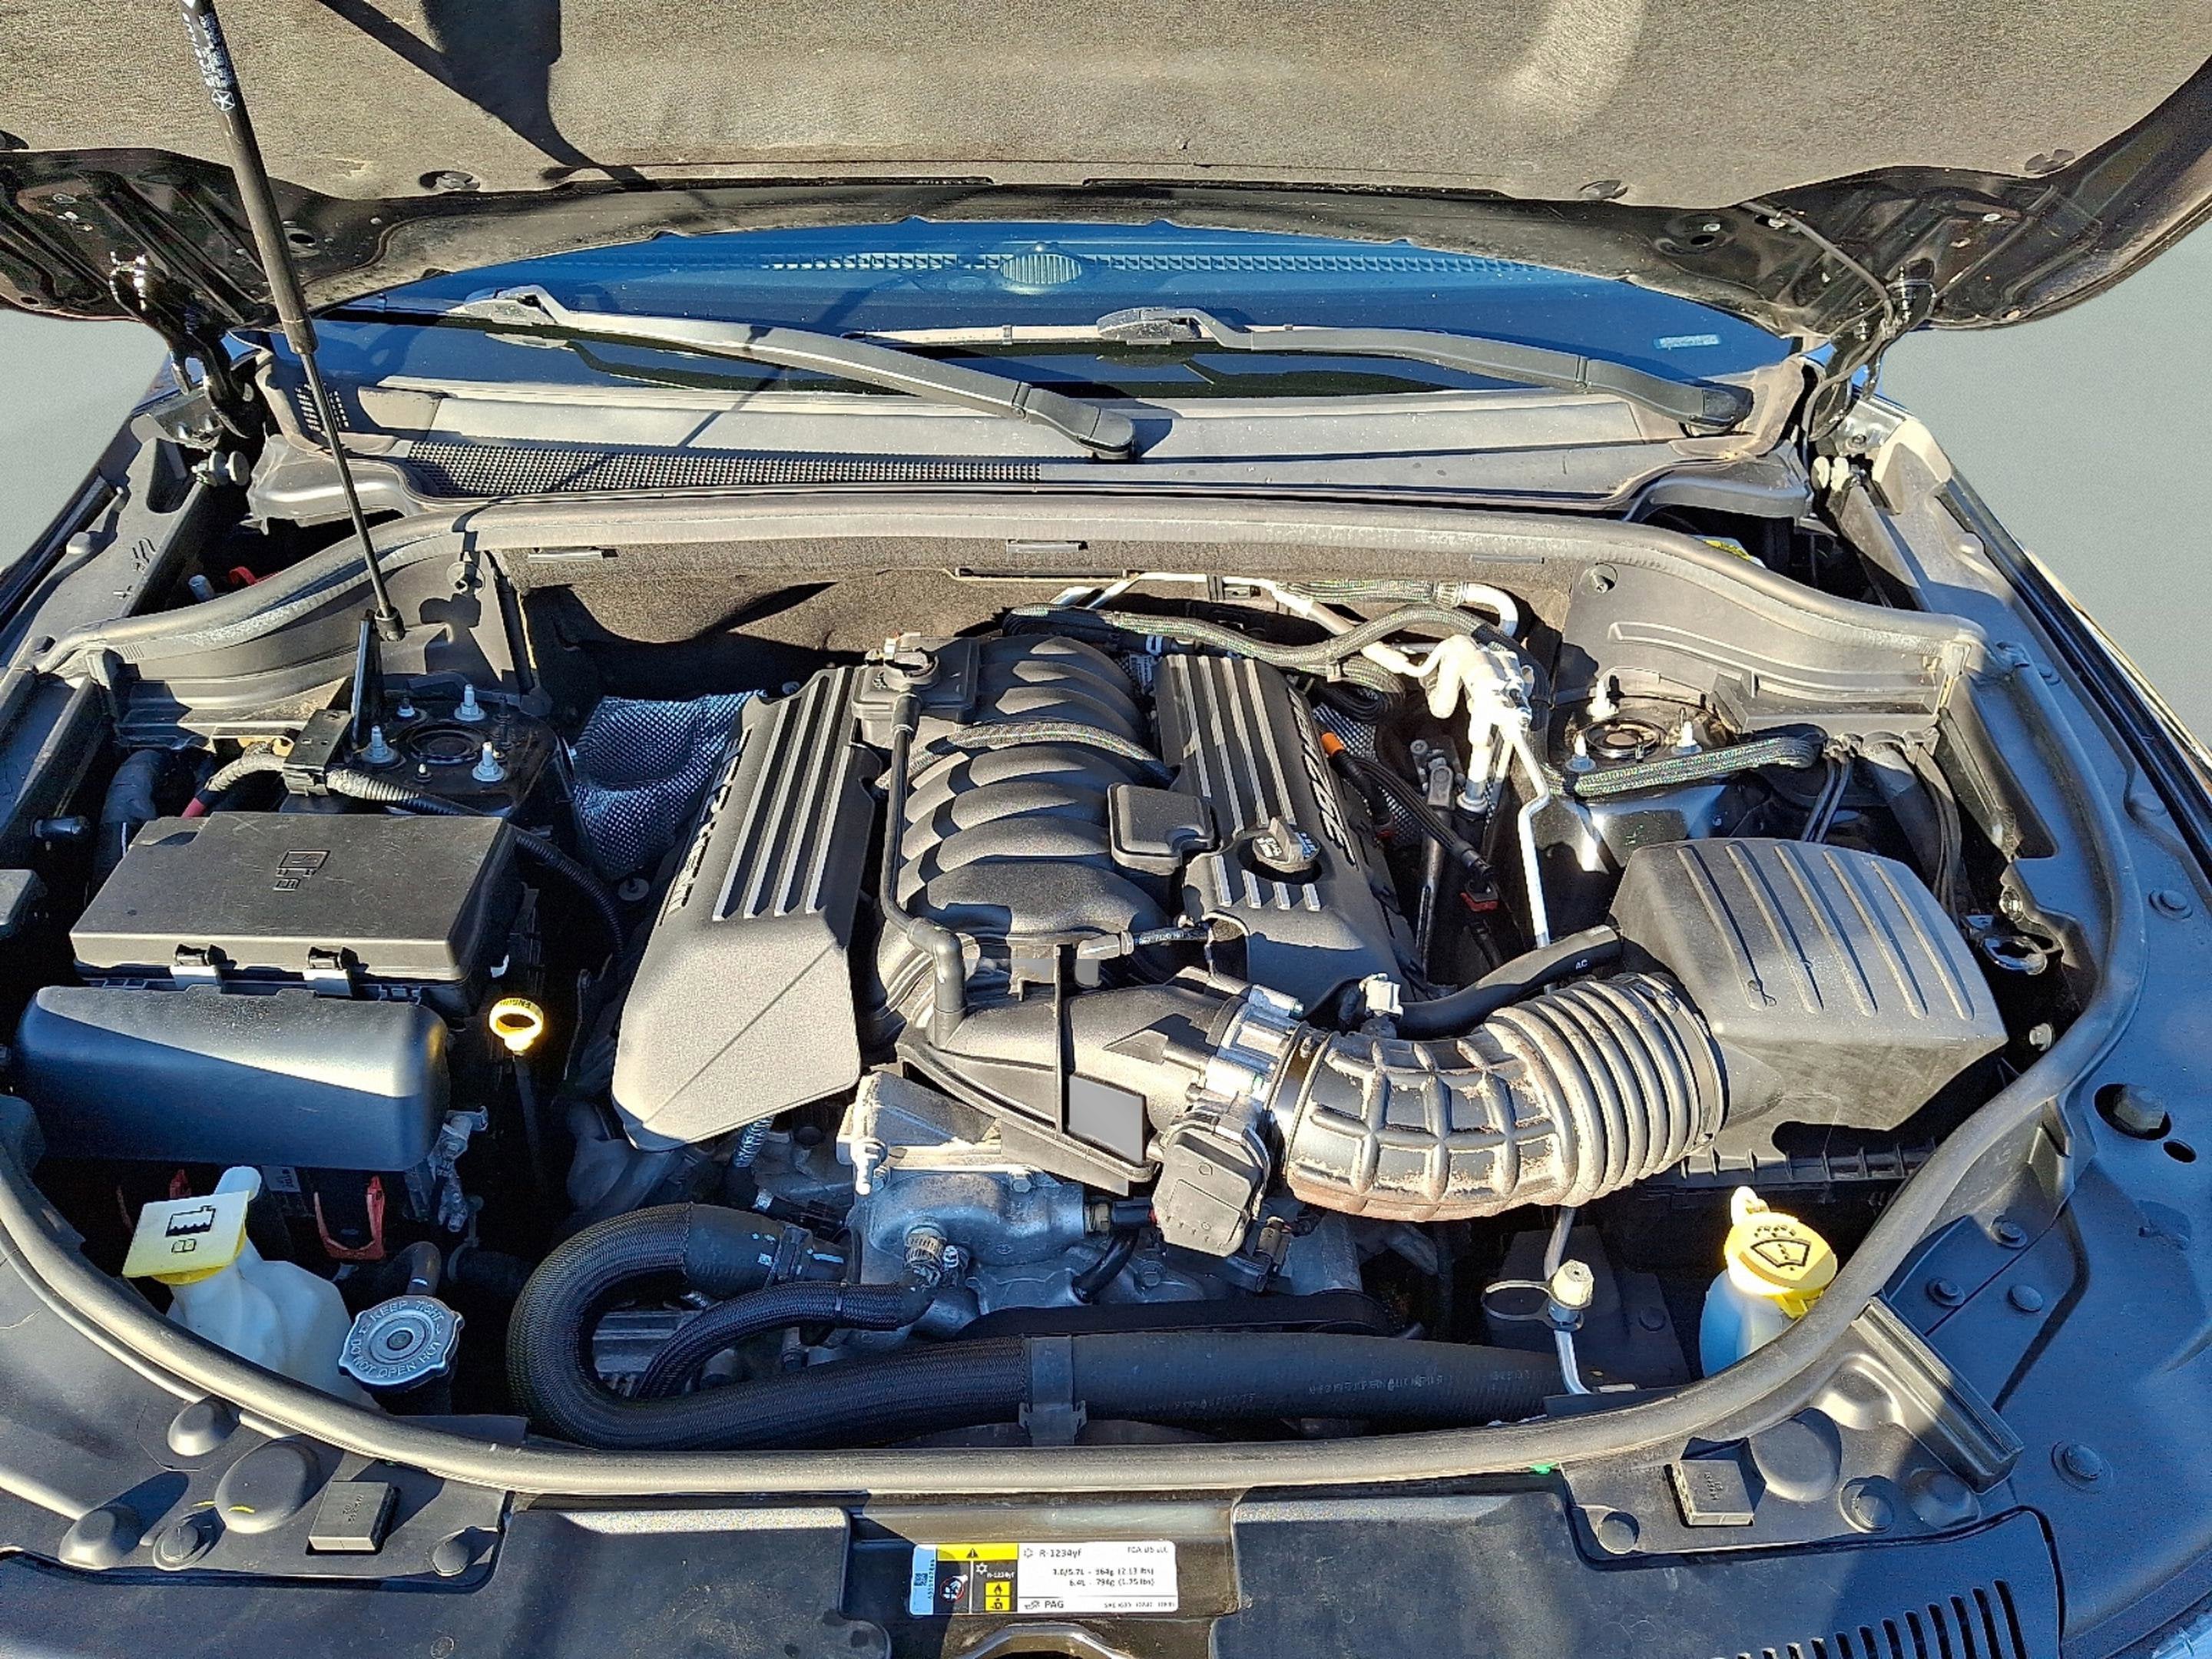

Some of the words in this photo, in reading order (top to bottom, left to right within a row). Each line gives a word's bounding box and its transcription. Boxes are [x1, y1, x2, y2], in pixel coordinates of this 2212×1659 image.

[1302, 751, 1358, 868] 392
[1575, 959, 1588, 970] AC
[369, 1300, 409, 1322] KEEP
[415, 1300, 444, 1322] TIGHT
[349, 1339, 363, 1356] DO
[418, 1341, 443, 1364] HOT
[352, 1354, 377, 1375] NOT
[375, 1362, 417, 1379] OPEN
[1038, 1548, 1082, 1559] R-1234yf
[1044, 1600, 1065, 1609] PAG
